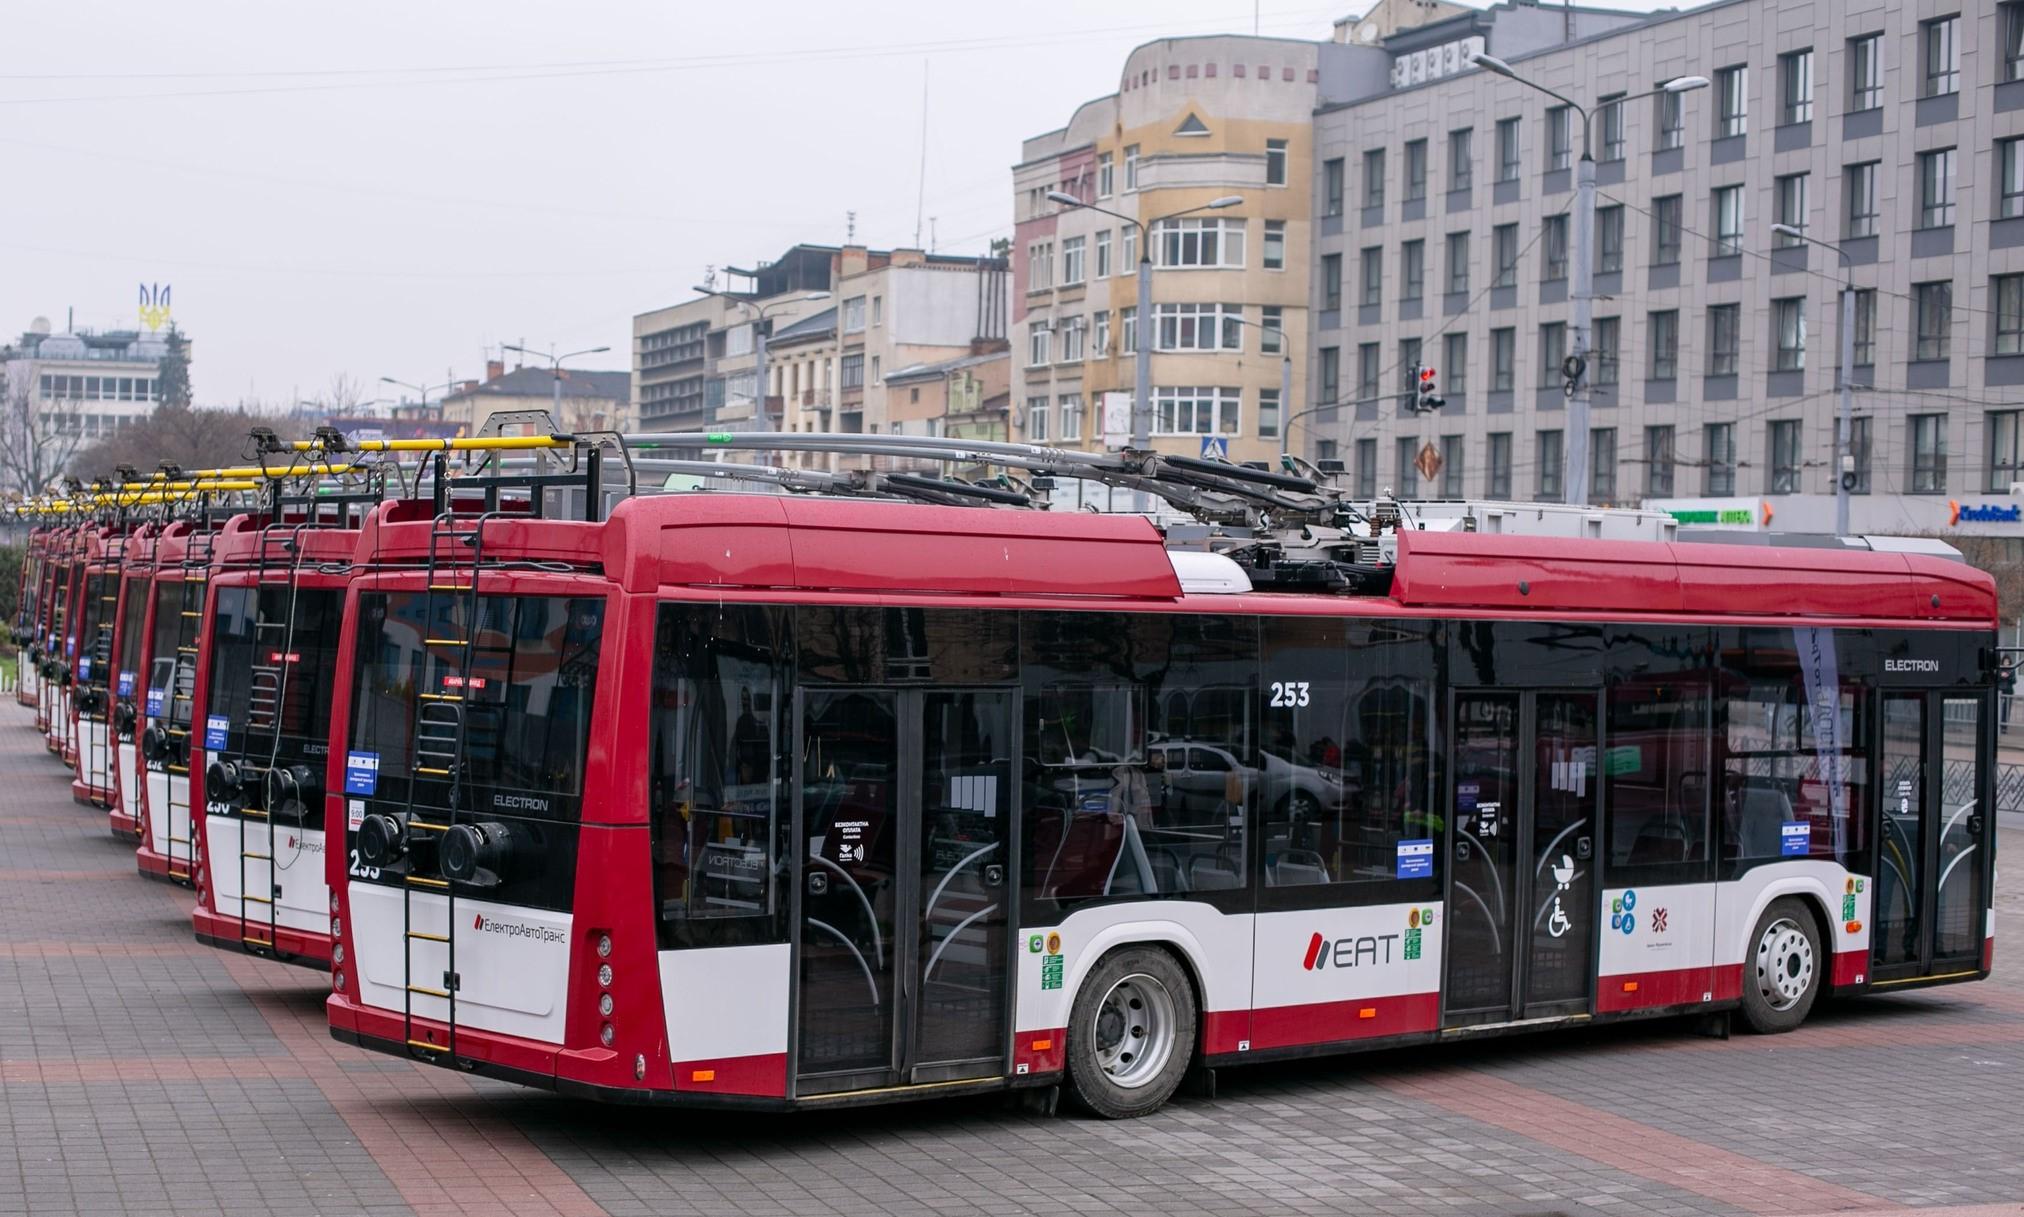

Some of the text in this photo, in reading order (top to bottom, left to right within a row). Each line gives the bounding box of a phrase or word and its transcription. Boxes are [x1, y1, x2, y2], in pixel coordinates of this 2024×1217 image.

[1885, 660, 1939, 671] ELECTRON
[1270, 681, 1310, 707] 253
[493, 794, 549, 811] ELECTRON
[484, 918, 566, 944] ЕлектроАвтоТранс
